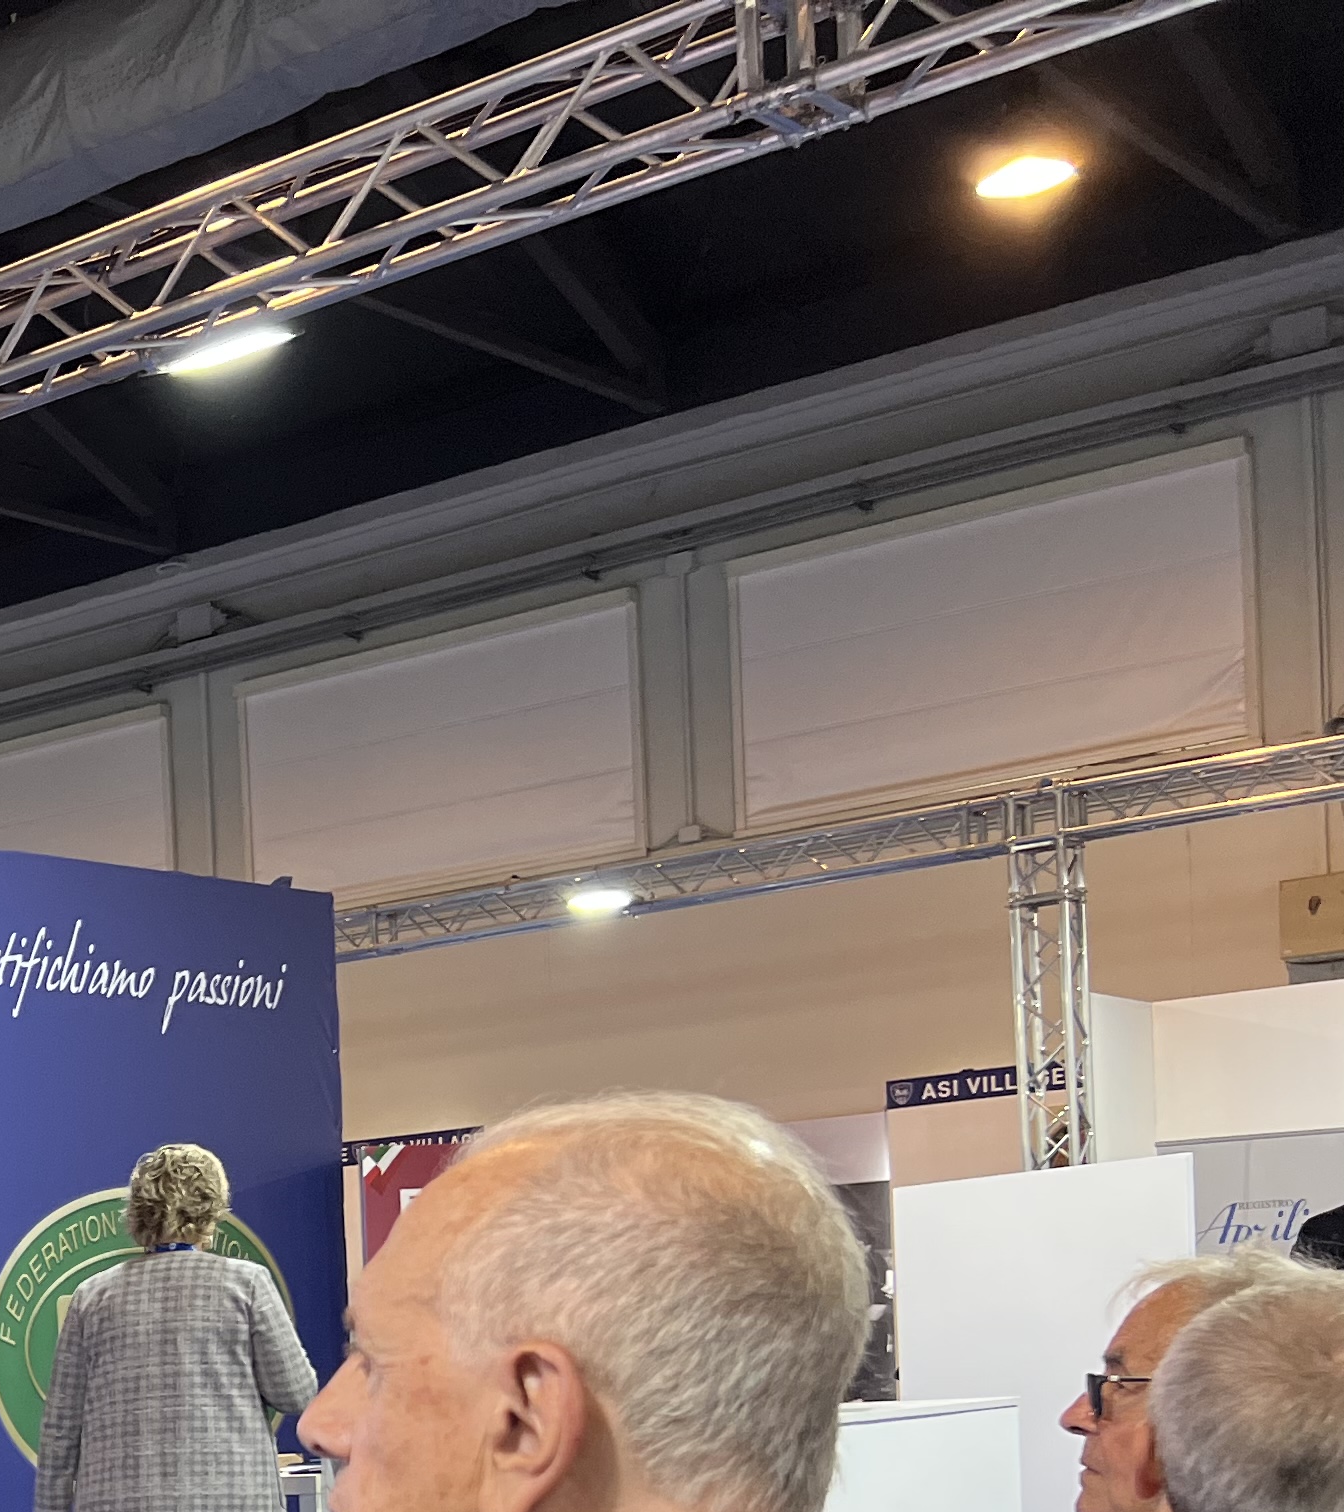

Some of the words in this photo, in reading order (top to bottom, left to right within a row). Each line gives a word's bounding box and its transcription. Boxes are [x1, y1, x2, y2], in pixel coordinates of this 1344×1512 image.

[161, 960, 288, 1034] passioni
[921, 1080, 959, 1100] ASI
[0, 1209, 117, 1346] FEDERATION
